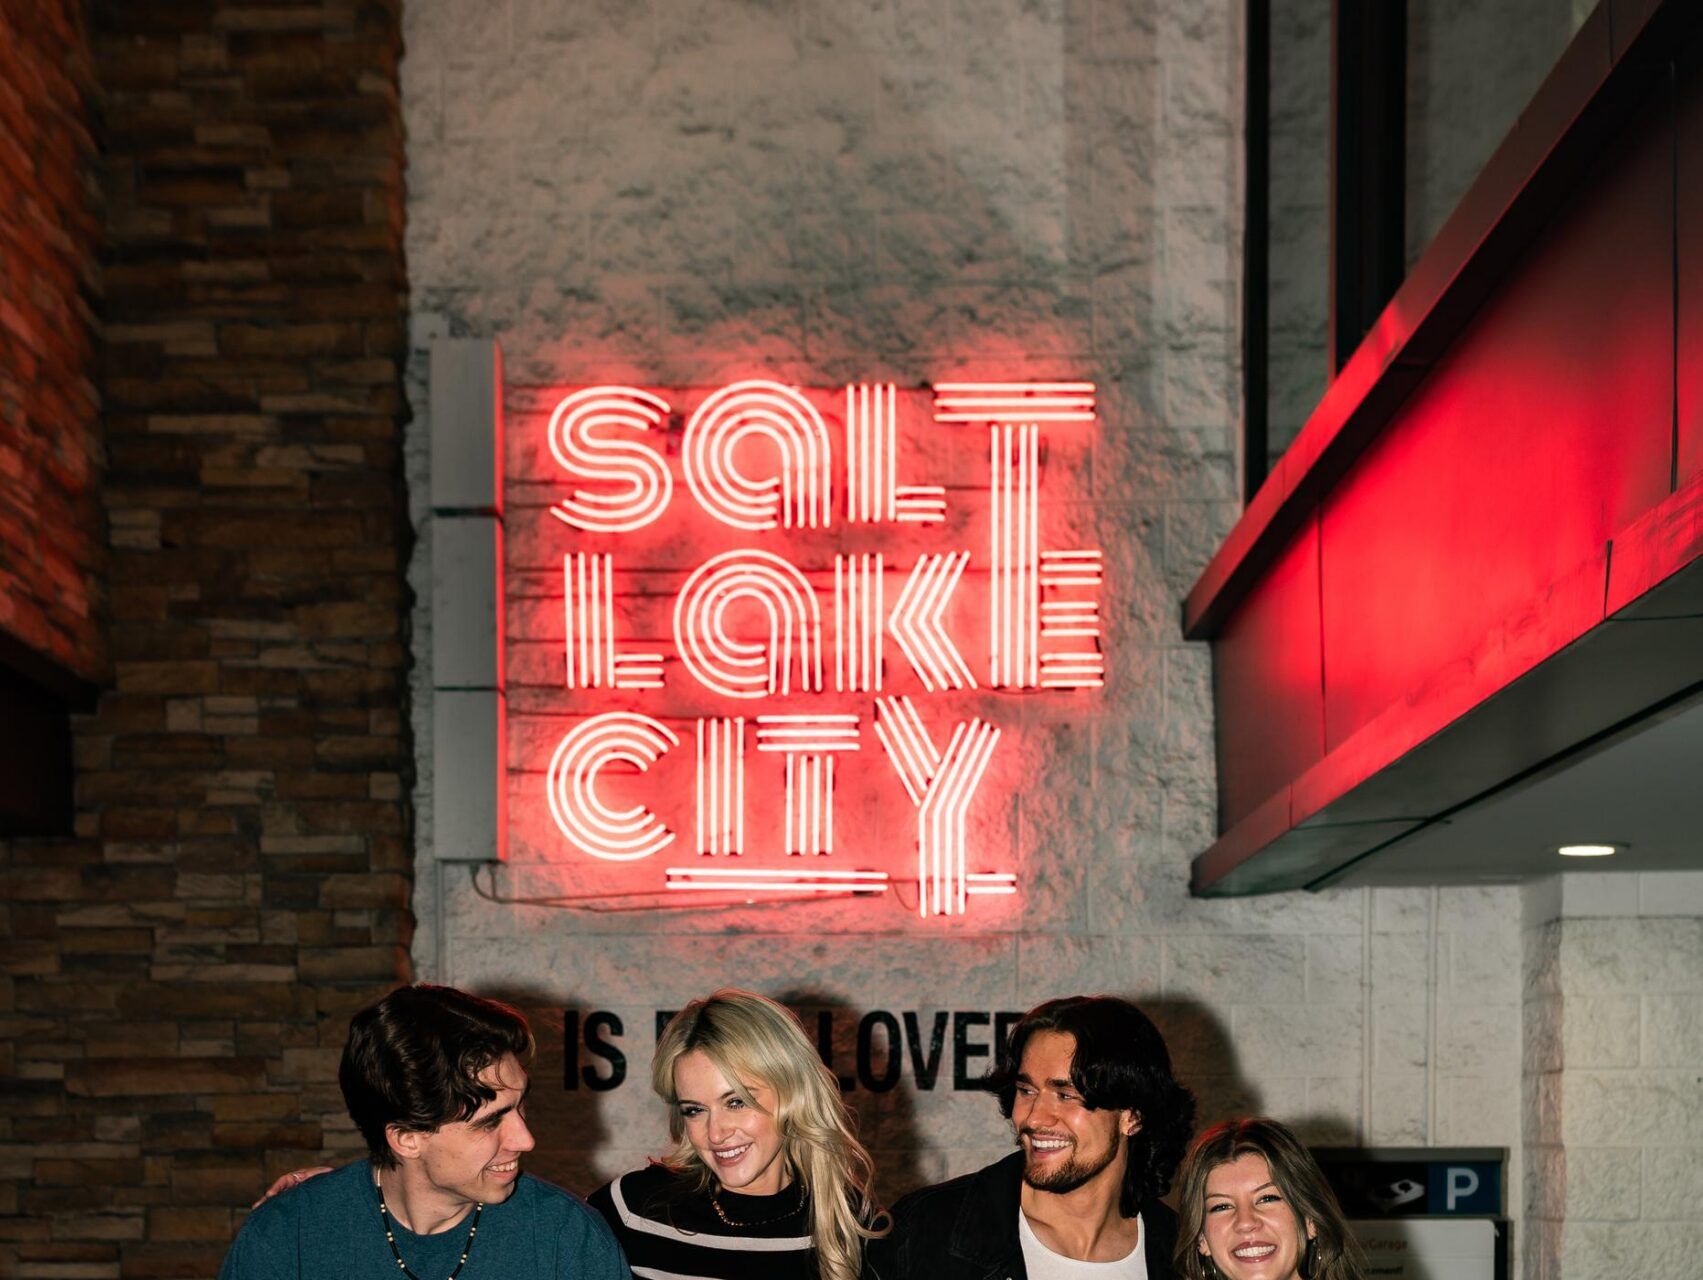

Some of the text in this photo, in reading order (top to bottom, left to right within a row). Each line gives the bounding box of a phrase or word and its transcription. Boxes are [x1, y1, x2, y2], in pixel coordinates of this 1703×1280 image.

[546, 695, 1017, 917] CITY
[563, 1011, 627, 1091] IS
[1446, 1167, 1479, 1210] P
